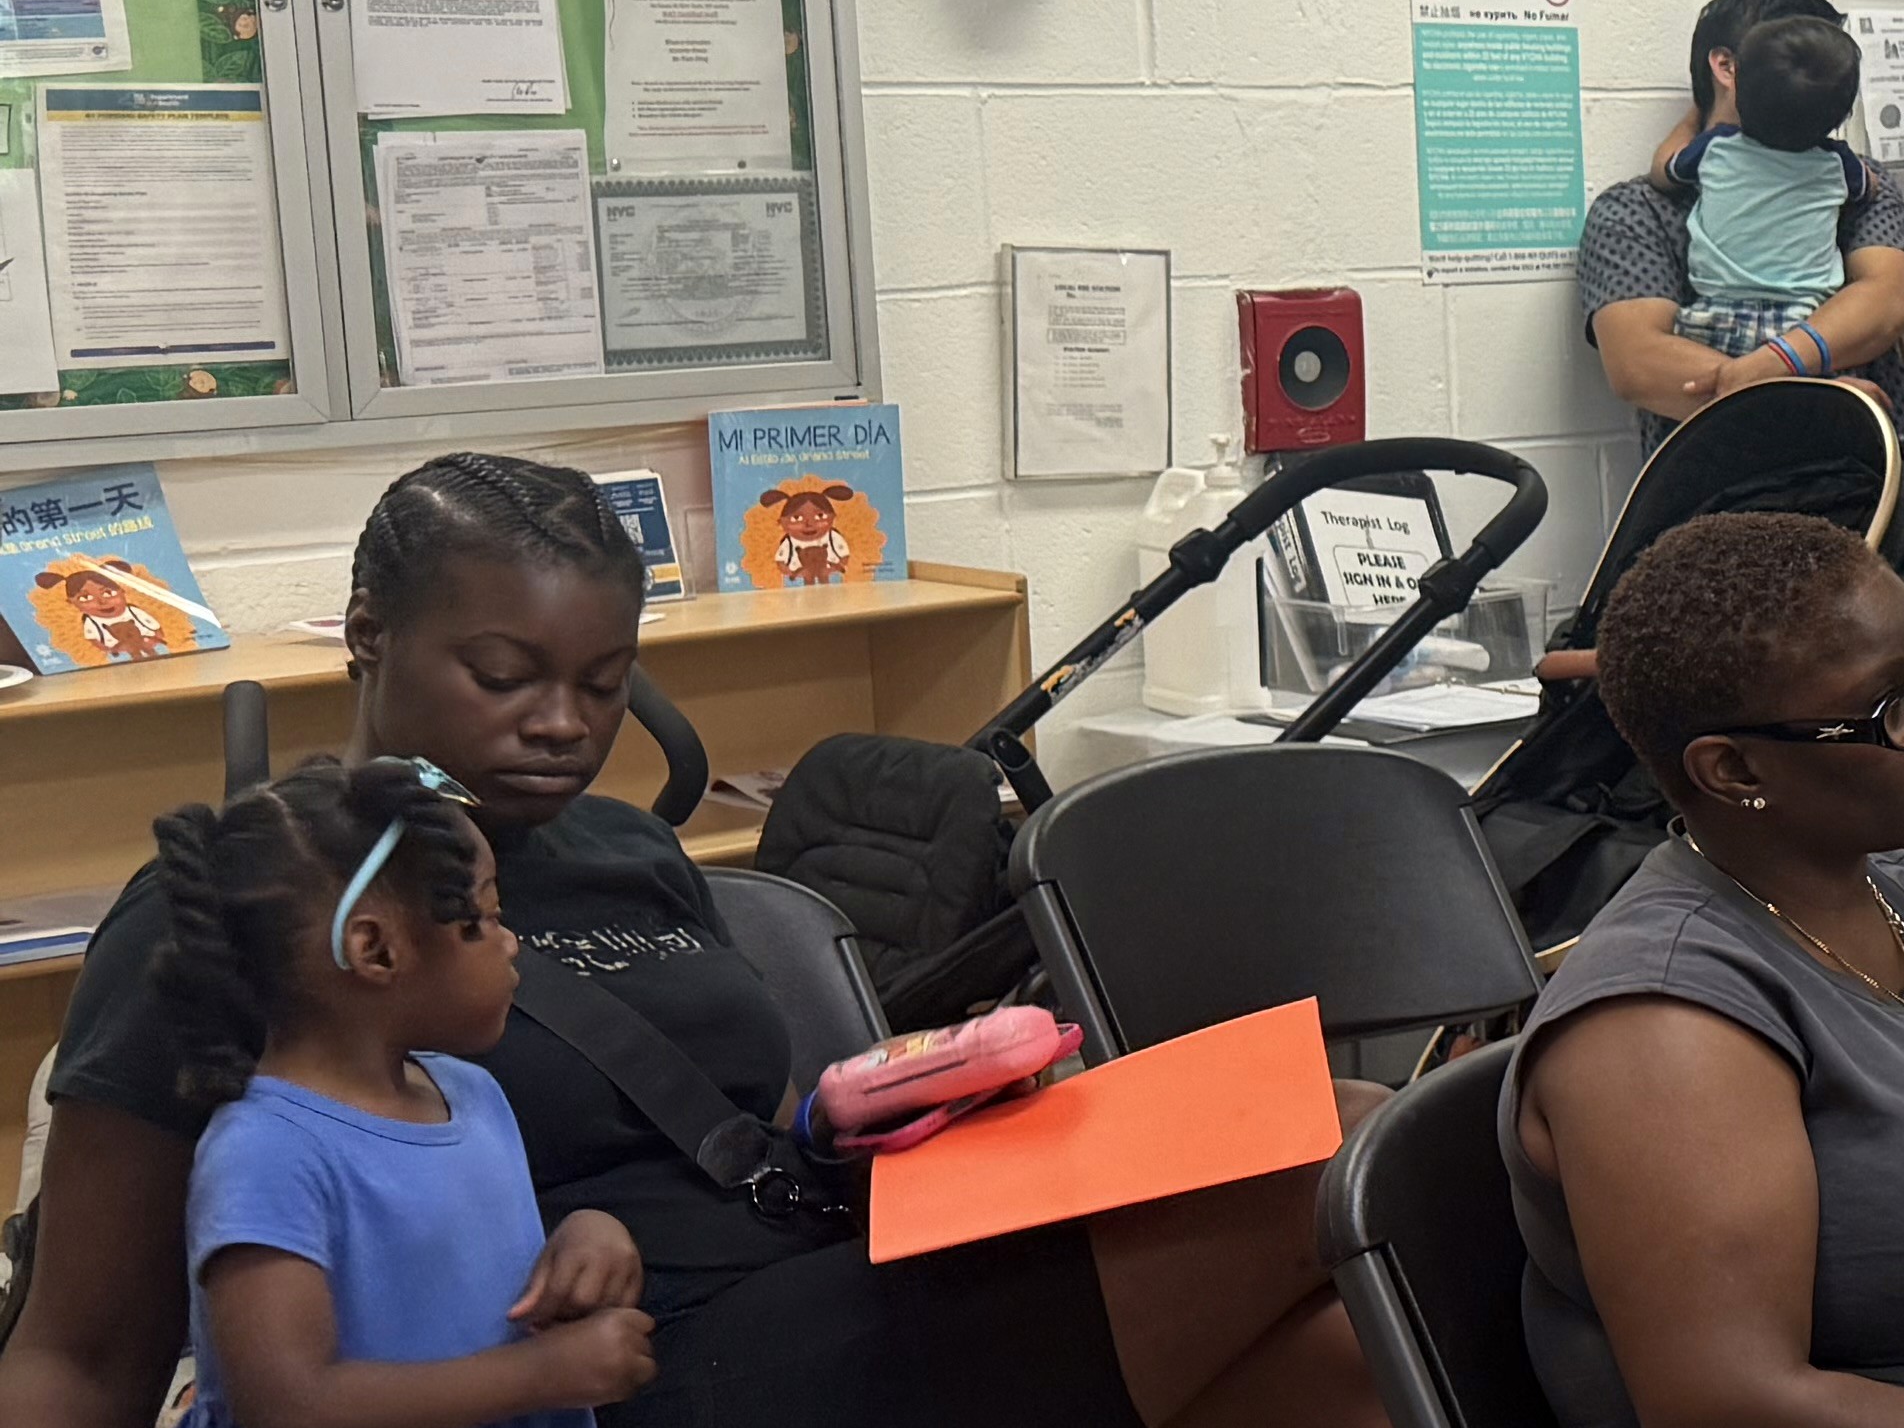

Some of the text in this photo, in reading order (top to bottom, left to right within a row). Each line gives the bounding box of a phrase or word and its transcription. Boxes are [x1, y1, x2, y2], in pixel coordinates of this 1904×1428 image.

[1524, 10, 1570, 21] No Fumar
[718, 429, 743, 452] MI
[753, 424, 843, 451] PRIMER
[0, 482, 144, 539] 的第一天
[1320, 510, 1411, 535] Therapist Log
[1357, 552, 1406, 570] PLEASE
[1343, 571, 1374, 588] SIGN
[1378, 573, 1392, 589] IN
